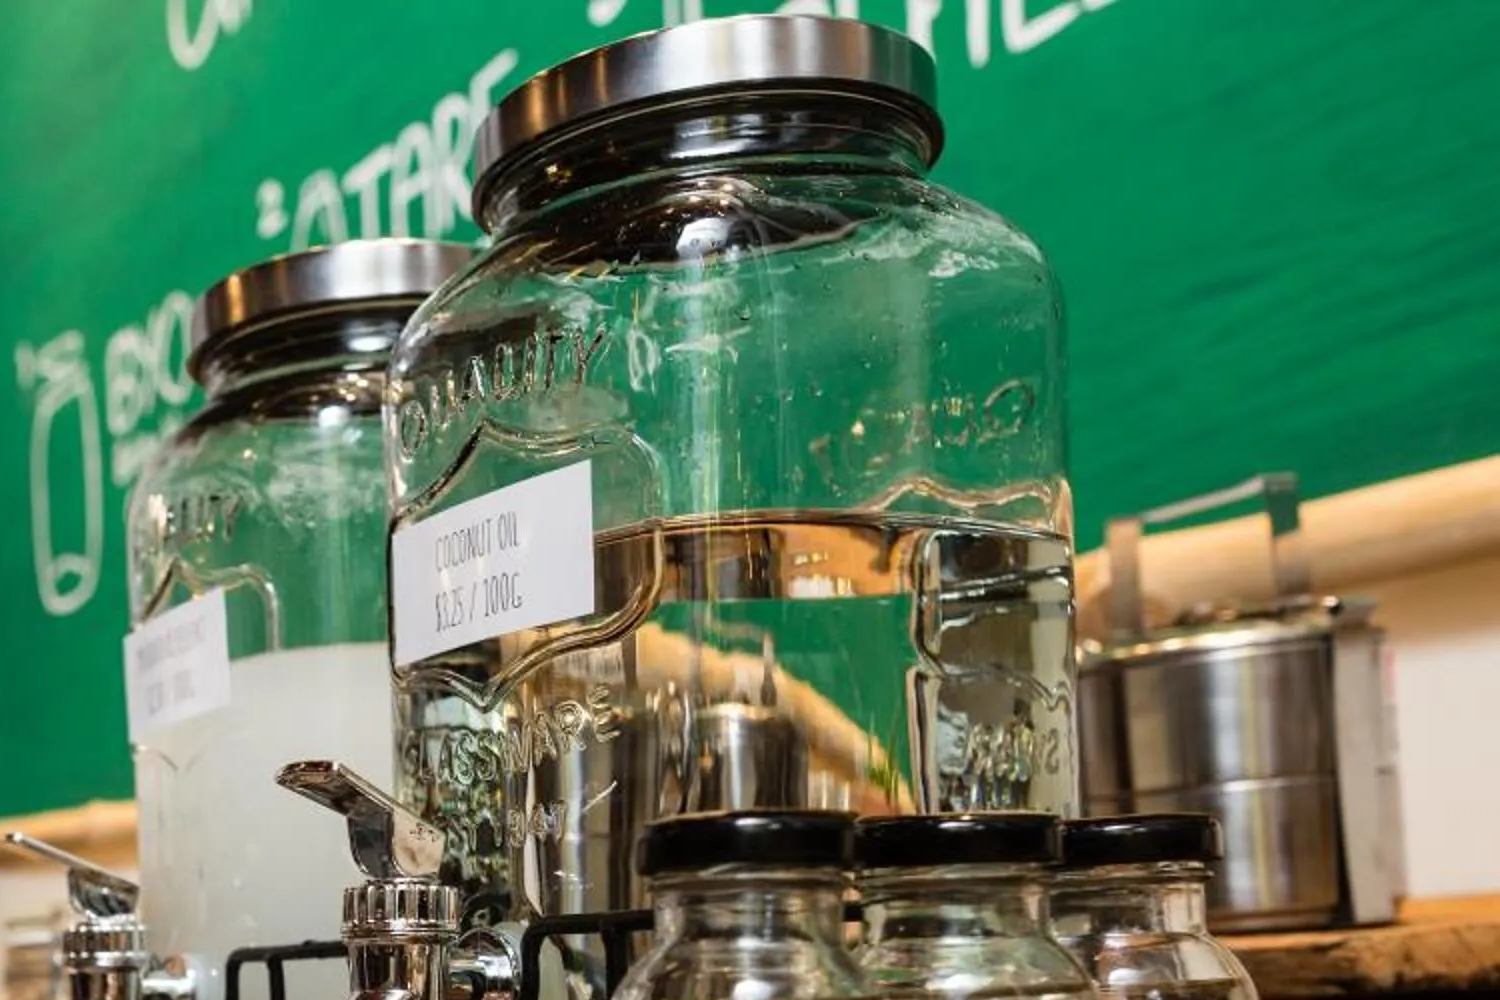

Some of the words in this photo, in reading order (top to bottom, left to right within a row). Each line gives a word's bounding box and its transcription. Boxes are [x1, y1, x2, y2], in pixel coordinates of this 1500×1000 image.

[434, 518, 492, 573] COCONUT
[497, 510, 520, 550] OIL
[483, 572, 522, 617] 100G
